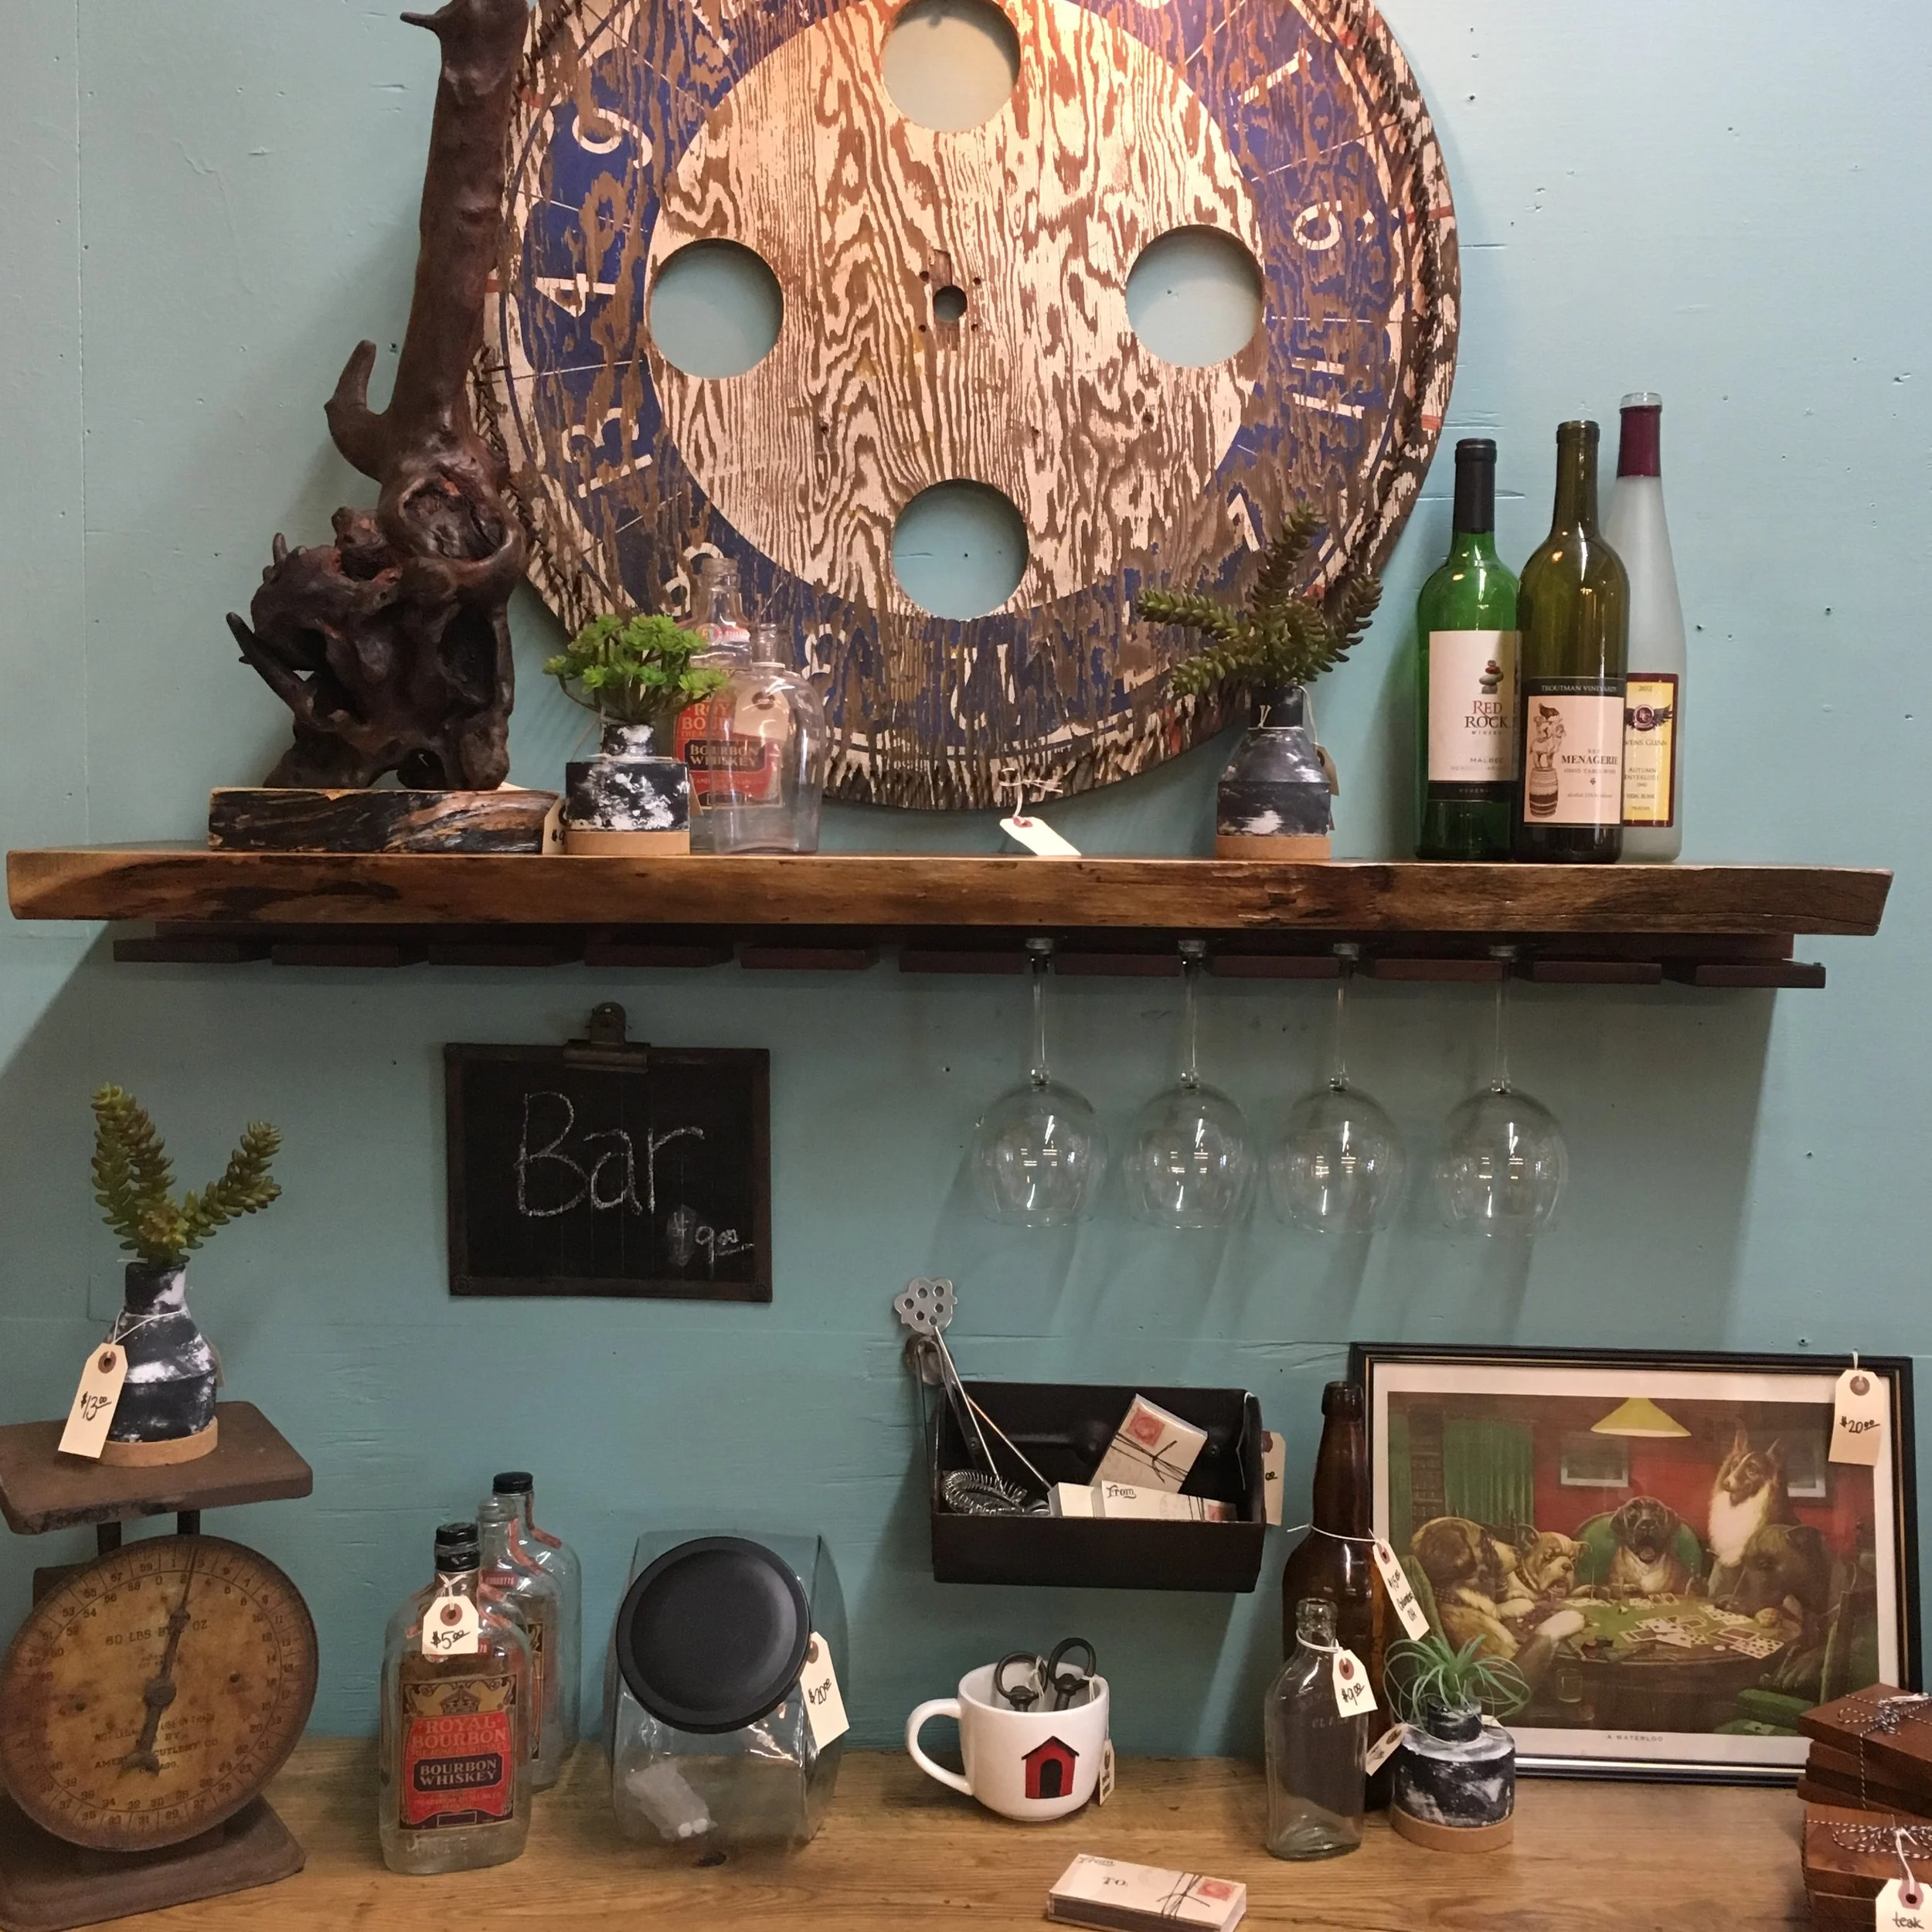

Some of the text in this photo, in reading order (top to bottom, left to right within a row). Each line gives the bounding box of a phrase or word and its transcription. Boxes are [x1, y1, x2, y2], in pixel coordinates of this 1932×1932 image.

[535, 272, 616, 318] 4
[1472, 700, 1503, 715] RED
[1464, 716, 1509, 729] ROCK
[690, 755, 756, 767] WHISKEY
[1561, 754, 1619, 766] MENAGERIE
[514, 1090, 705, 1217] Bar
[1106, 1484, 1138, 1499] From
[155, 1575, 163, 1585] 0
[62, 1606, 76, 1617] 53
[83, 1608, 97, 1618] 54
[105, 1635, 123, 1646] 60
[129, 1630, 151, 1643] LBS
[426, 1716, 496, 1734] ROYAL
[412, 1727, 507, 1749] BOURBON
[1616, 1734, 1664, 1743] WATERLOO
[420, 1758, 498, 1776] BOURBON
[420, 1769, 498, 1786] WHISKEY
[1891, 1911, 1925, 1930] teak
